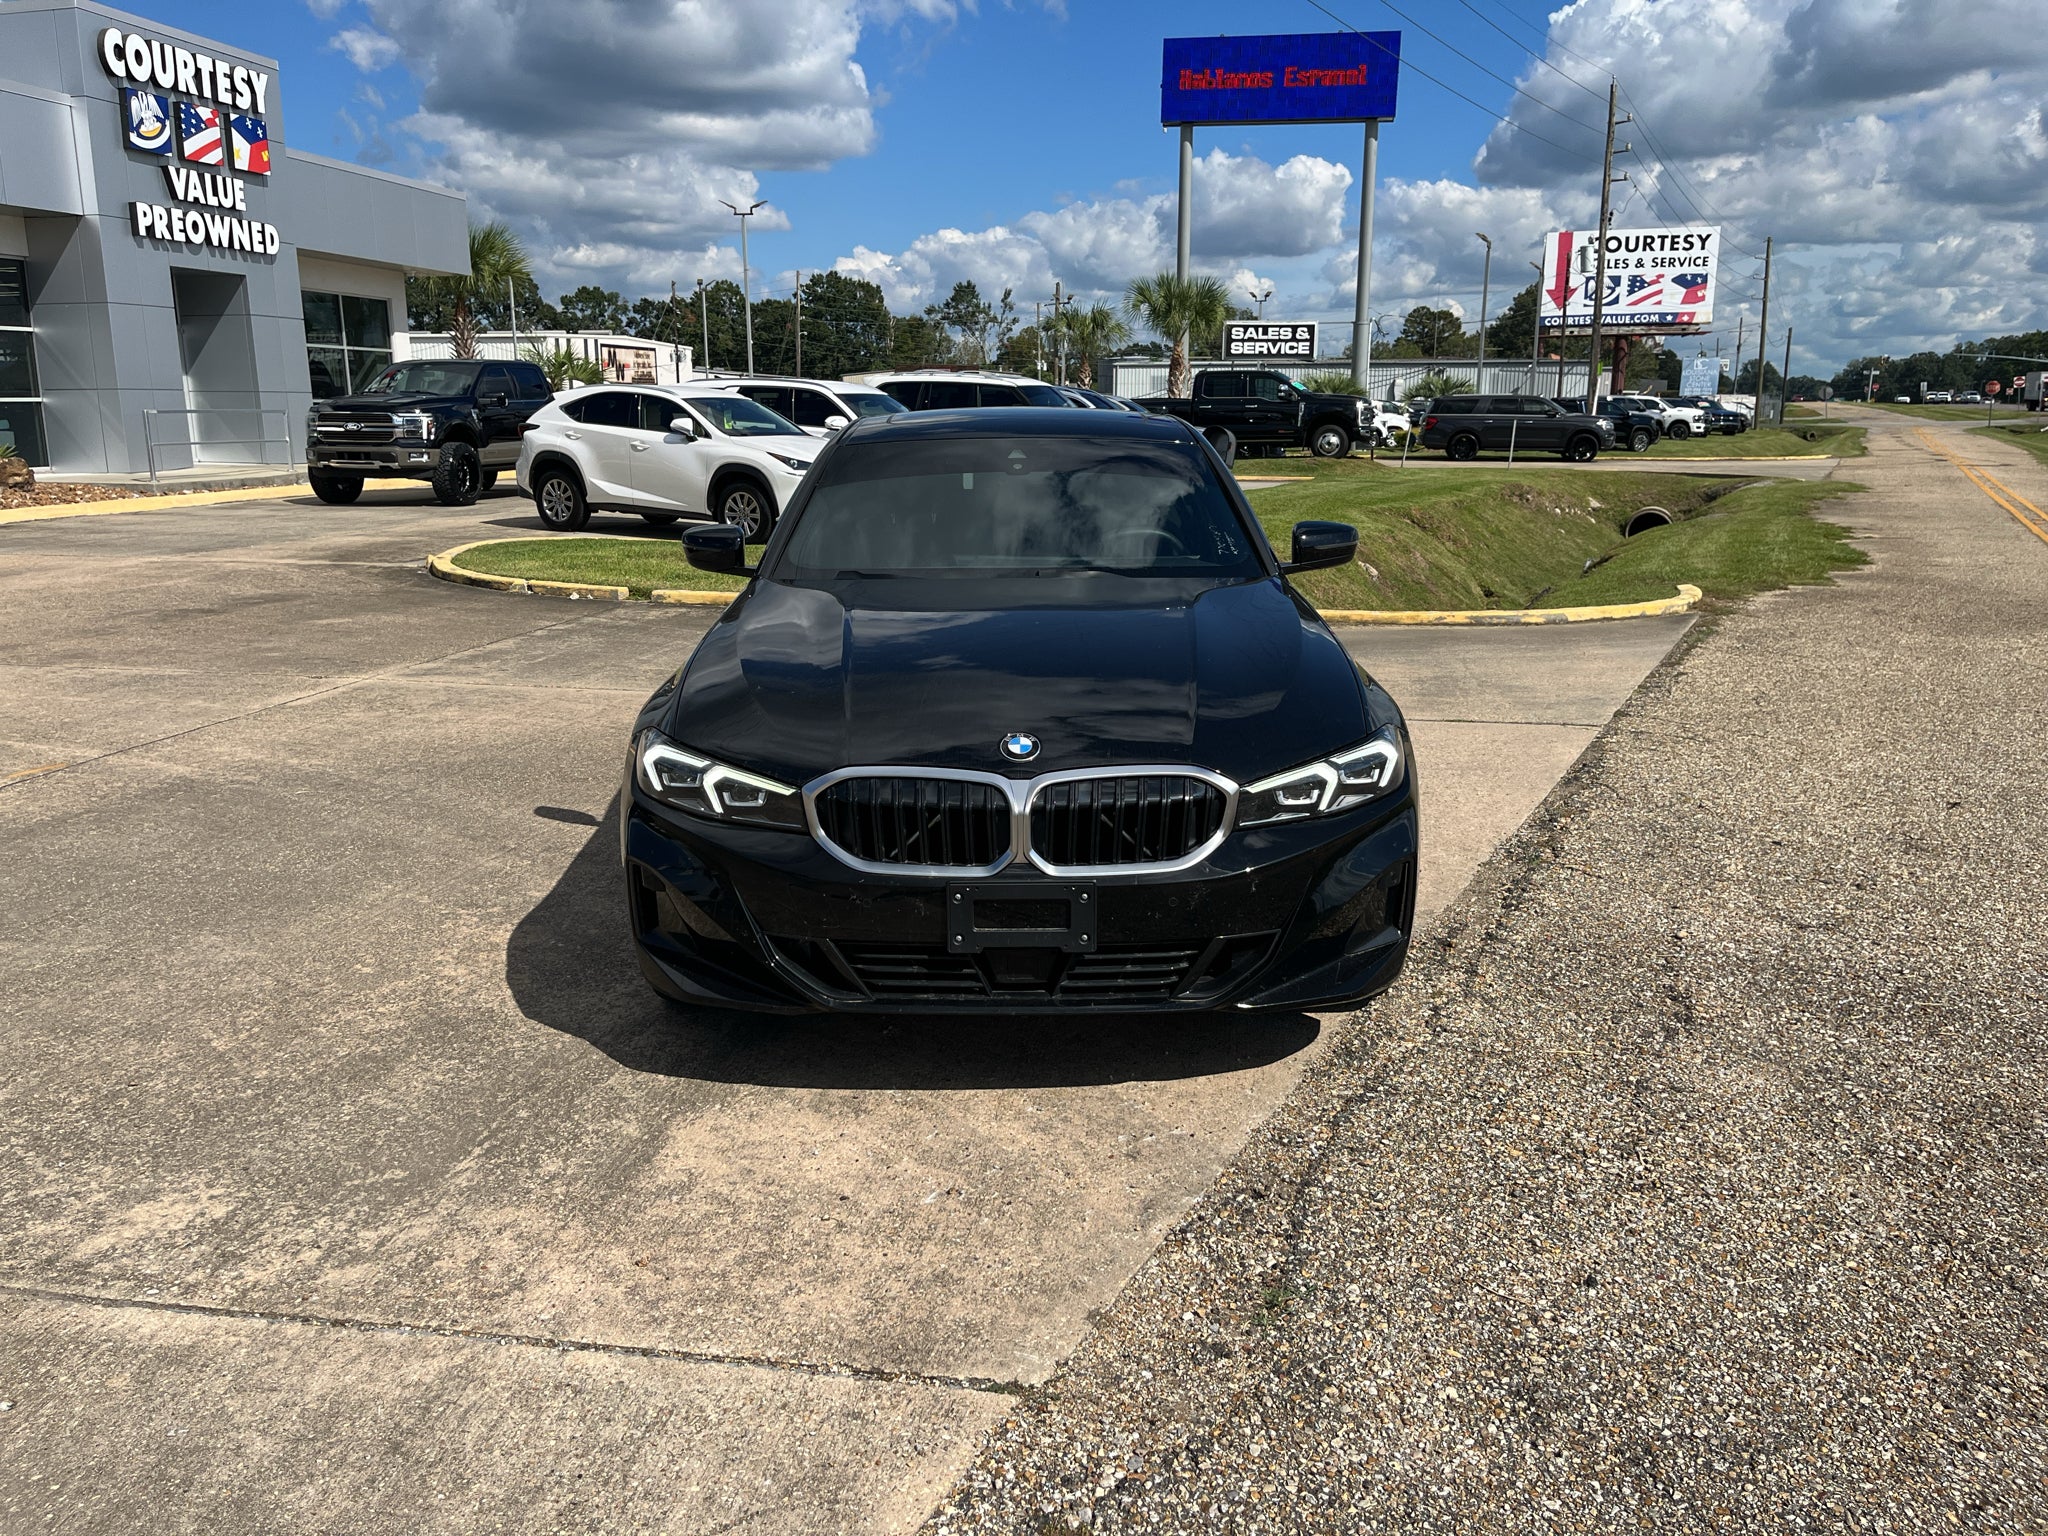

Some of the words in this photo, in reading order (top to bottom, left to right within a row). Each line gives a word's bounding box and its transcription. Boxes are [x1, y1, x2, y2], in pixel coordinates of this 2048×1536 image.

[101, 27, 268, 114] COURTESY
[166, 165, 247, 212] VALUE
[134, 201, 280, 255] PREOWNED
[1594, 233, 1713, 254] OURTESY
[1634, 257, 1645, 269] &
[1650, 256, 1710, 268] SERVICE
[1231, 327, 1292, 339] SALES
[1295, 327, 1310, 339] &
[1230, 342, 1310, 354] SERVICE
